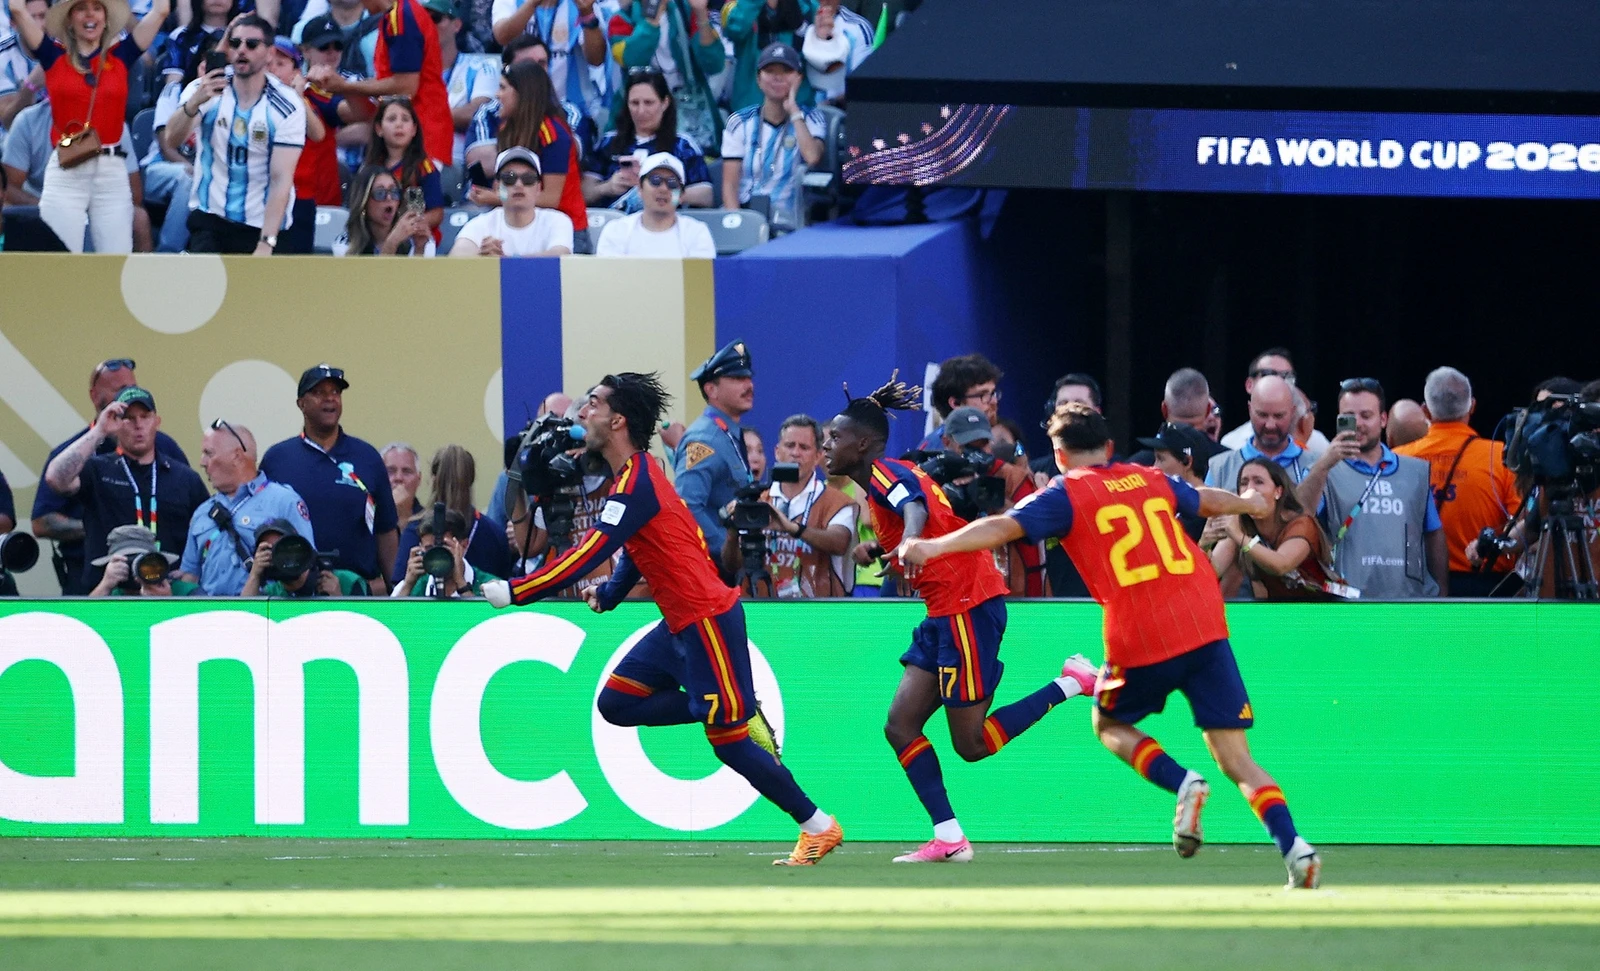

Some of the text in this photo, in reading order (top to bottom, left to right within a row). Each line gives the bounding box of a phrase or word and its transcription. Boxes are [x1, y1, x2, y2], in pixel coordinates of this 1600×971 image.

[227, 143, 248, 168] 10
[1197, 136, 1600, 172] FIFA WORLD CUP 2026
[1103, 473, 1148, 493] PEDRI
[1363, 497, 1404, 516] 1290
[1095, 497, 1195, 588] 20
[1361, 554, 1405, 566] FIFA.com
[938, 666, 957, 698] 17
[0, 609, 784, 830] amco
[703, 693, 719, 725] 7
